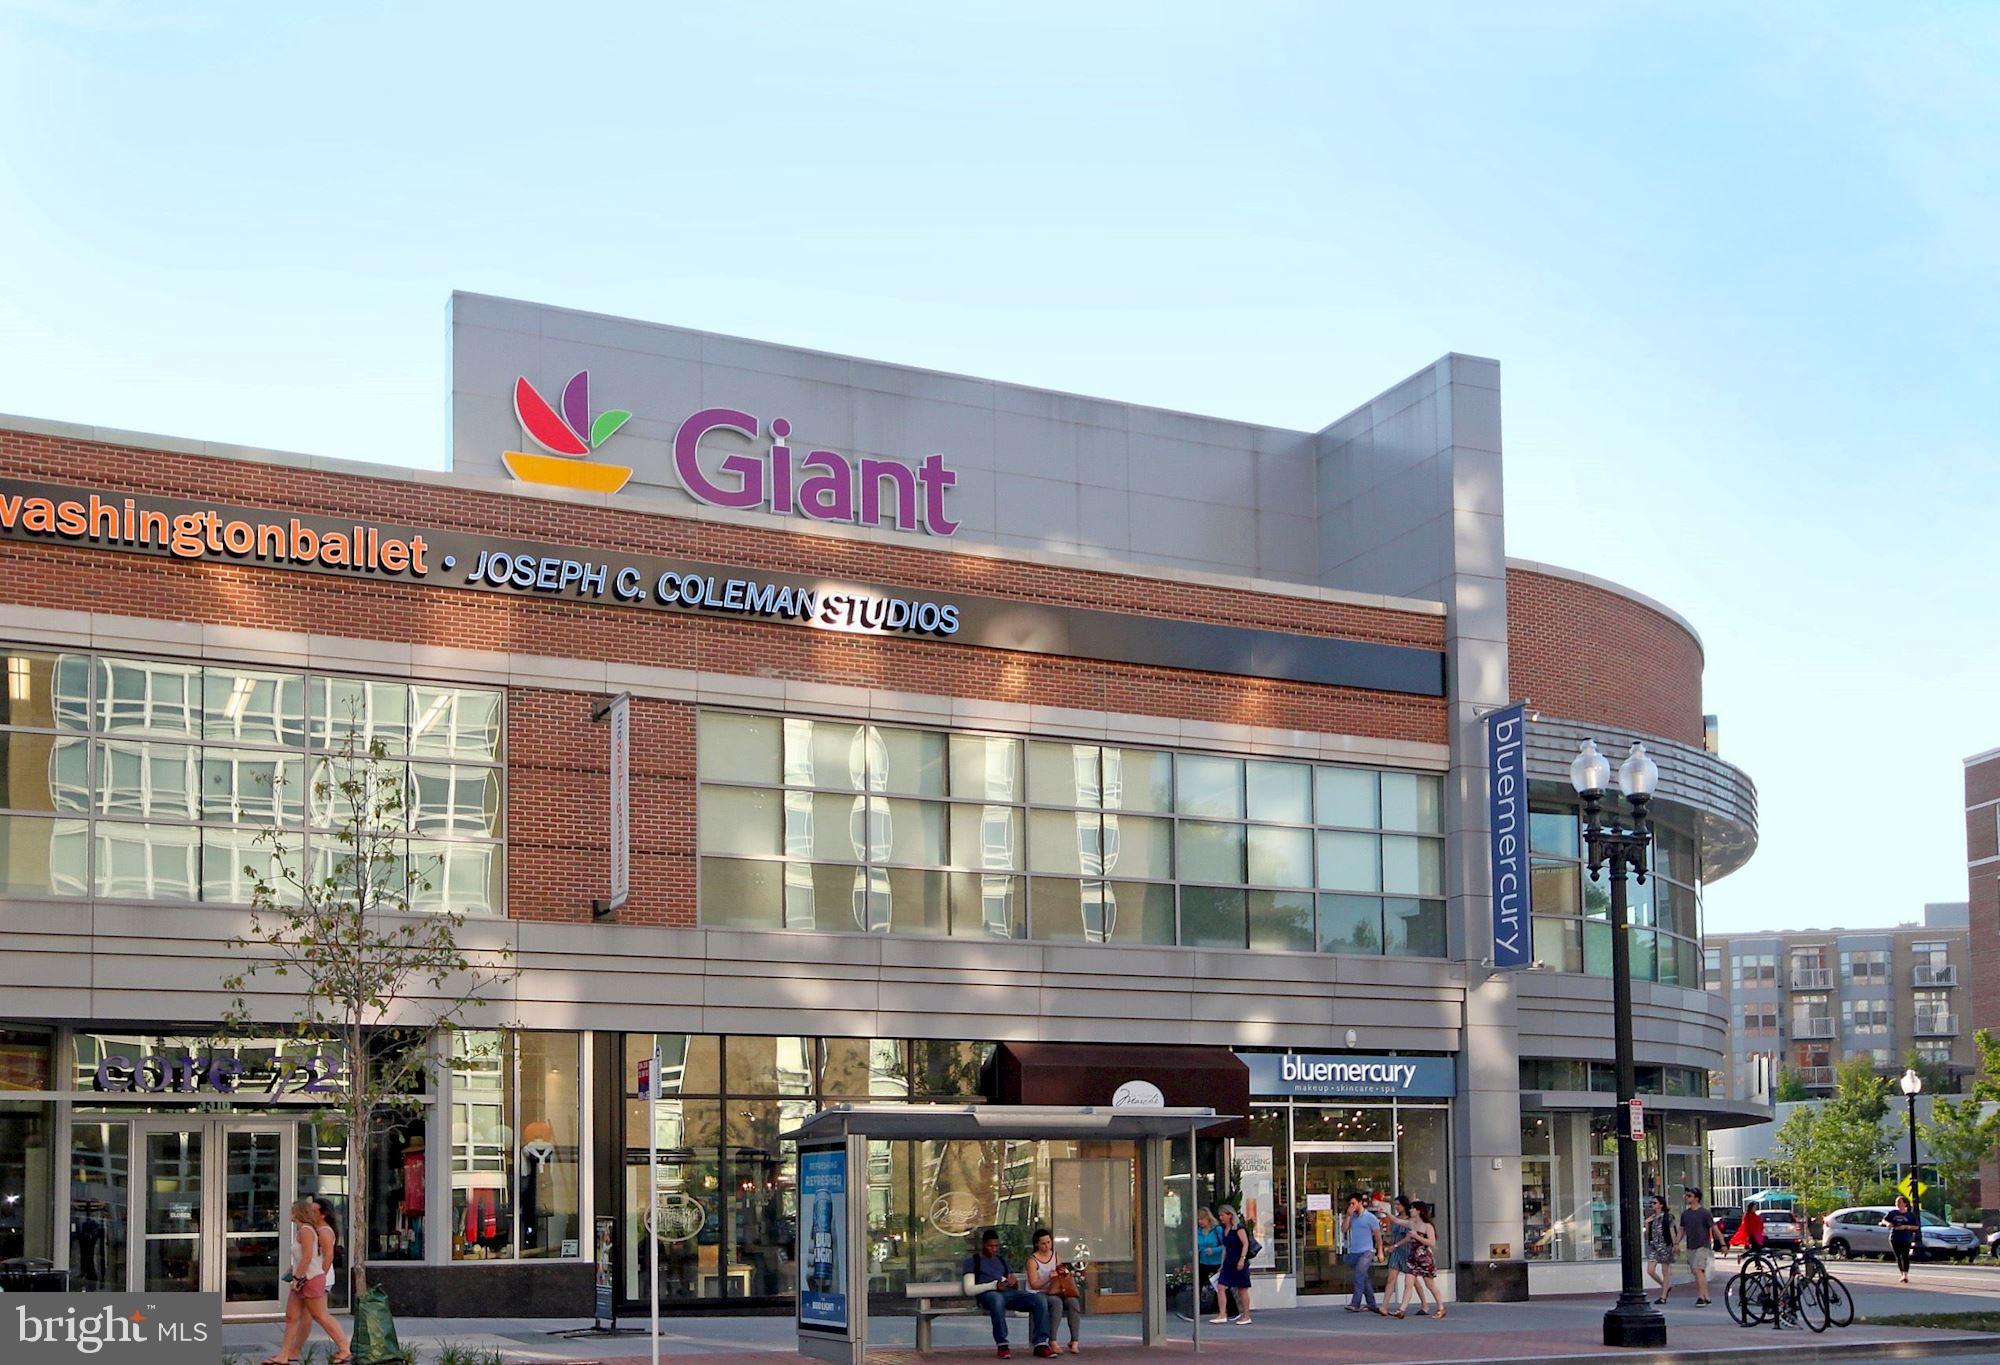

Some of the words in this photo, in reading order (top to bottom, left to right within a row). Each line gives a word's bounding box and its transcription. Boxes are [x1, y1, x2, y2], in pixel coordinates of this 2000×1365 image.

[672, 407, 962, 537] Giant
[467, 551, 608, 595] JOSEPH
[615, 566, 647, 599] C.
[656, 570, 820, 617] COLEMAN
[821, 589, 961, 635] STUDIOS
[1495, 716, 1521, 955] bluemercury
[98, 1055, 244, 1093] core
[1282, 1054, 1417, 1089] bluemercury
[1294, 1083, 1329, 1094] makeup
[1336, 1083, 1374, 1093] skincare
[1381, 1086, 1396, 1094] spa
[815, 1231, 832, 1248] BUD
